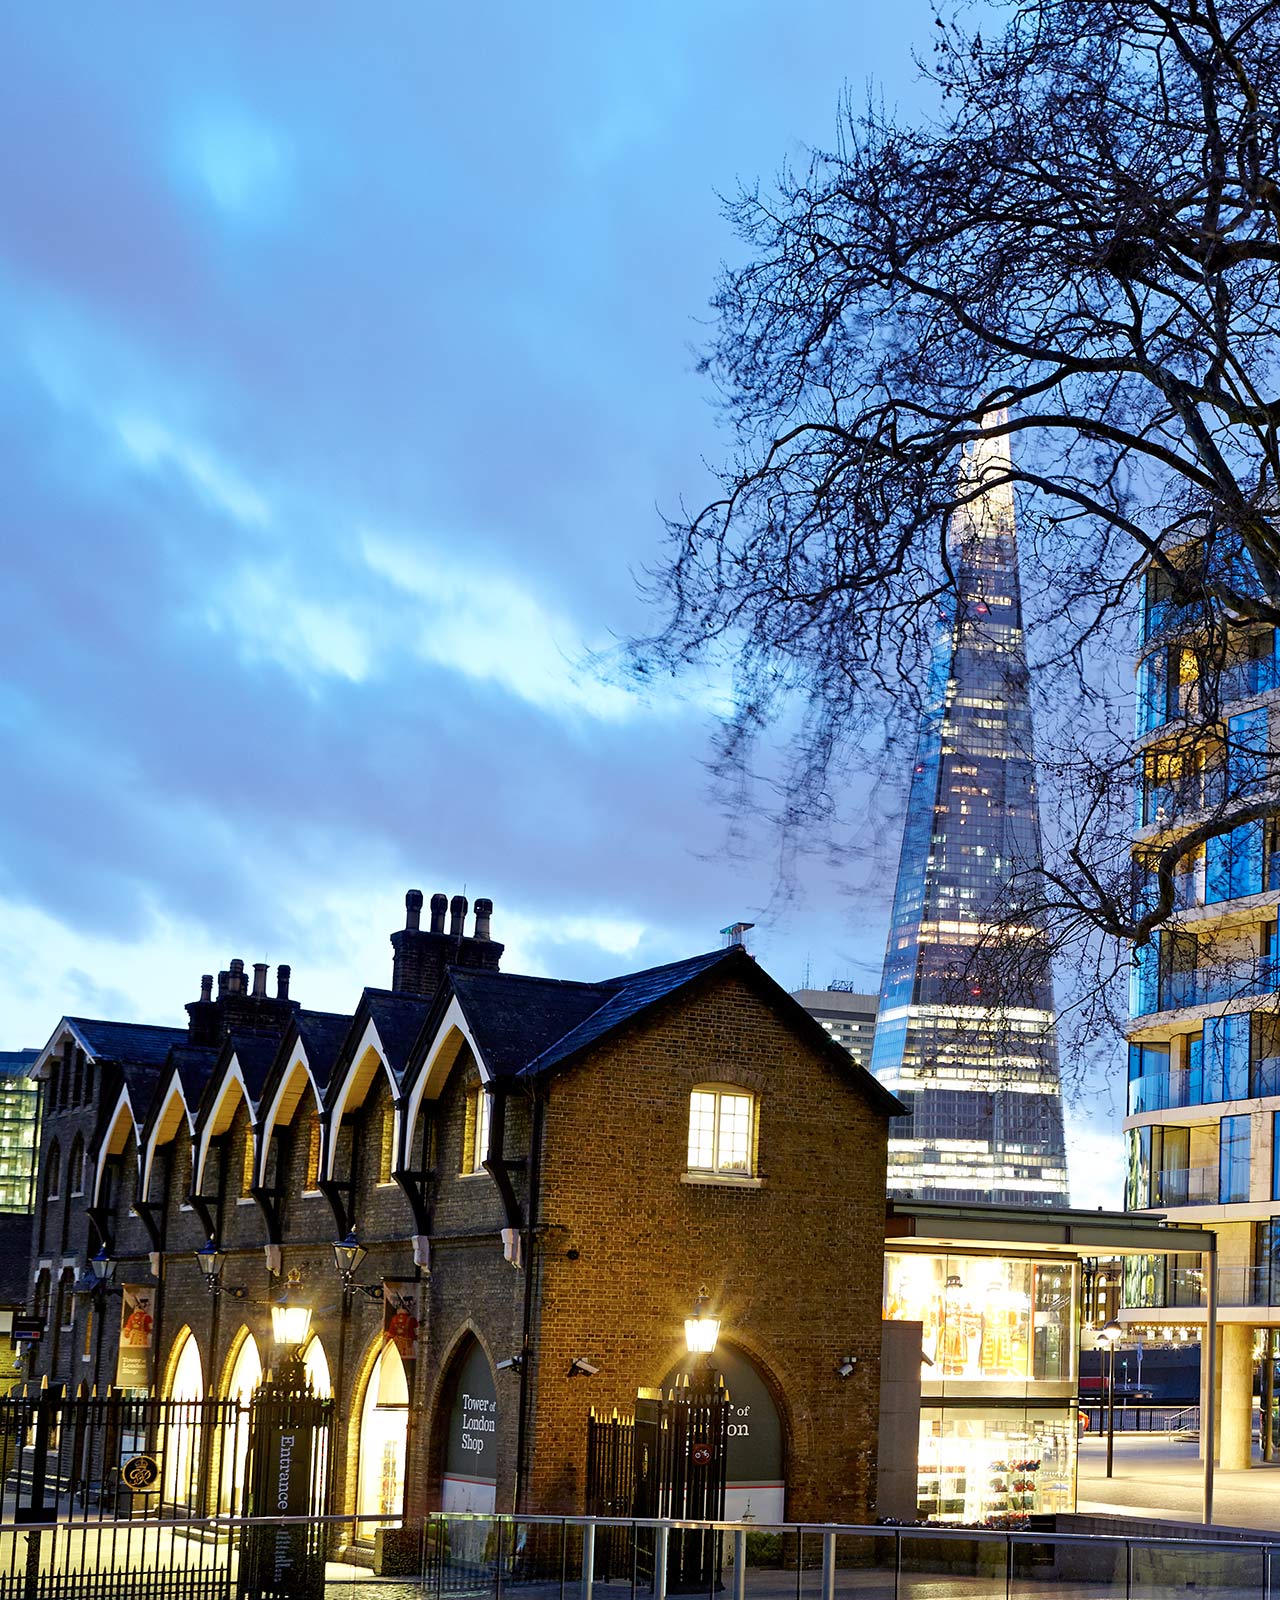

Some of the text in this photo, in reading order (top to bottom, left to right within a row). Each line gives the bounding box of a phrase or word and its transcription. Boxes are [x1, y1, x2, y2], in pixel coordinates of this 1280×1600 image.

[462, 1394, 496, 1412] Tower of
[736, 1405, 750, 1416] of
[462, 1413, 495, 1432] London
[461, 1433, 484, 1455] Shop
[277, 1435, 295, 1510] Entrance
